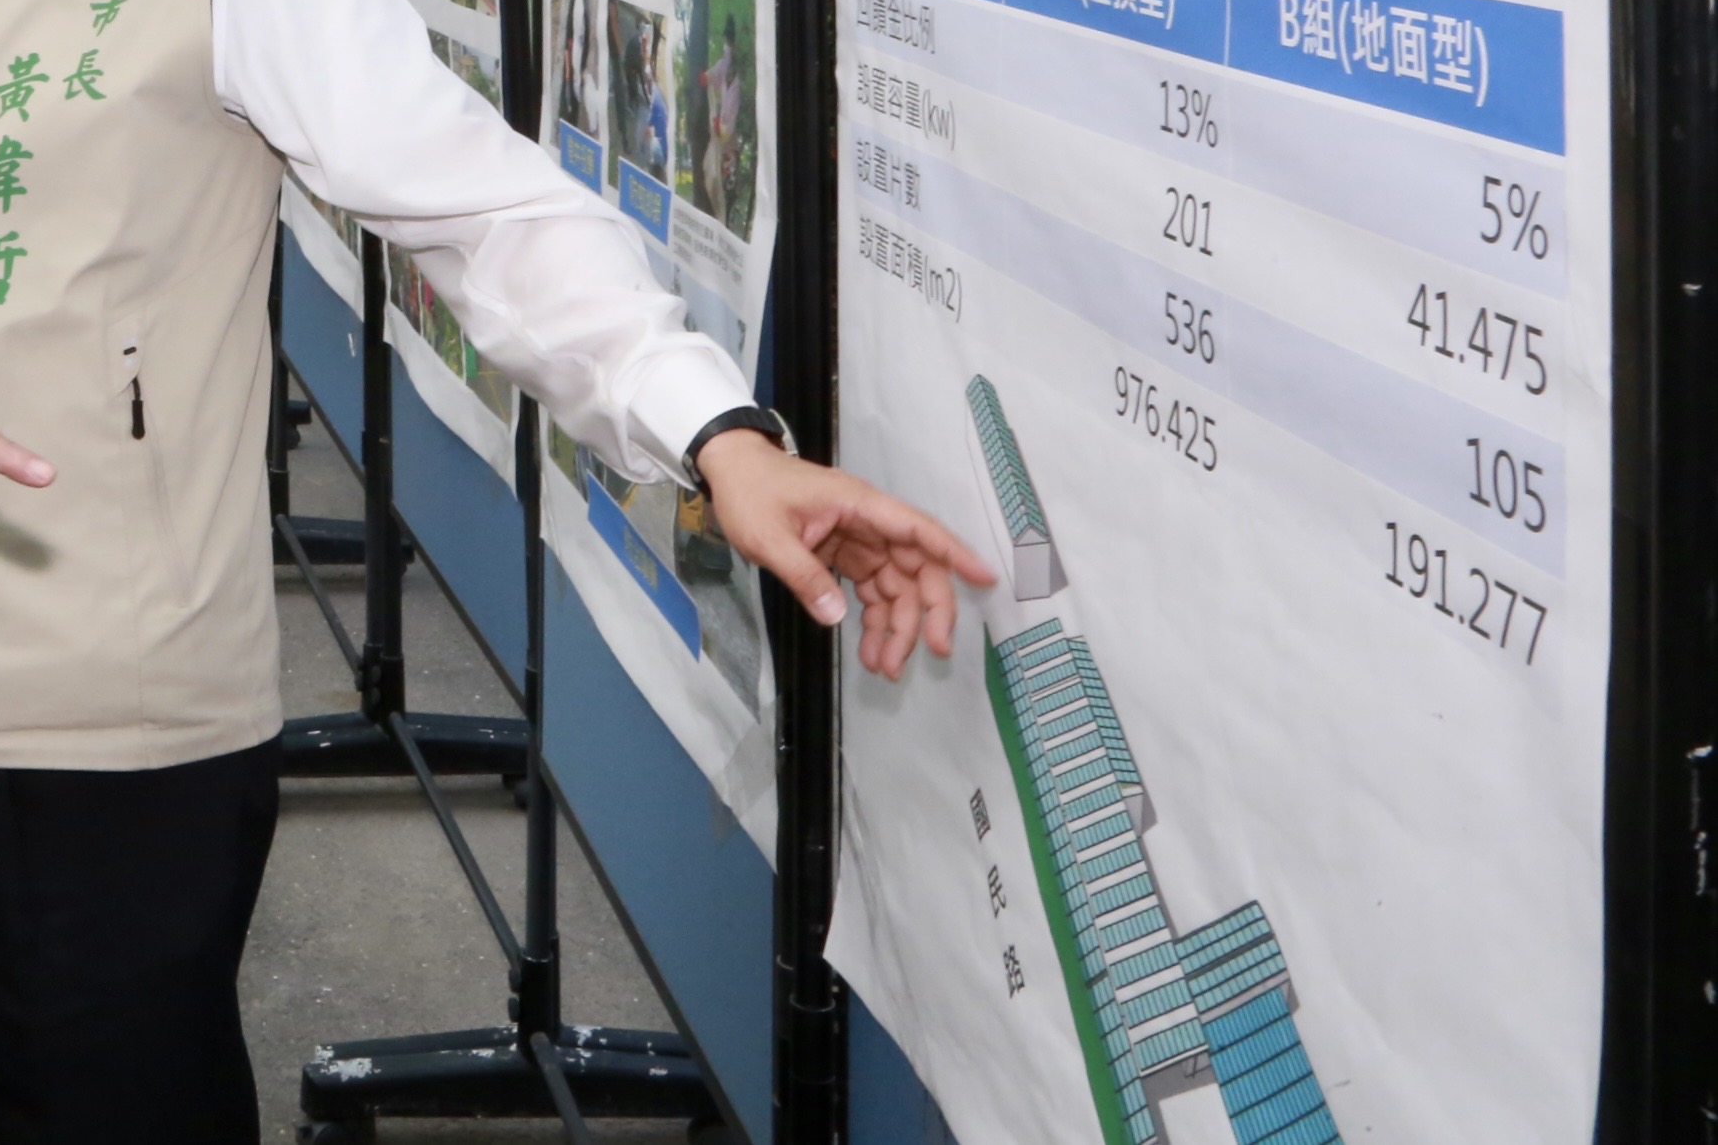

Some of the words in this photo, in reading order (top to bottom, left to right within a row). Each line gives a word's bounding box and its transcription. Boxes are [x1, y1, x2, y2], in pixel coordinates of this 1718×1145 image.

[856, 63, 957, 151] 設置容量(kw)
[1159, 79, 1219, 149] 13%
[856, 141, 922, 213] 設置片數
[1479, 174, 1550, 261] 5%
[1163, 186, 1215, 258] 201
[1164, 291, 1217, 365] 536
[1406, 282, 1549, 397] 41.475
[1113, 364, 1219, 473] 976.425
[1464, 435, 1548, 533] 105
[1383, 520, 1548, 666] 191.277
